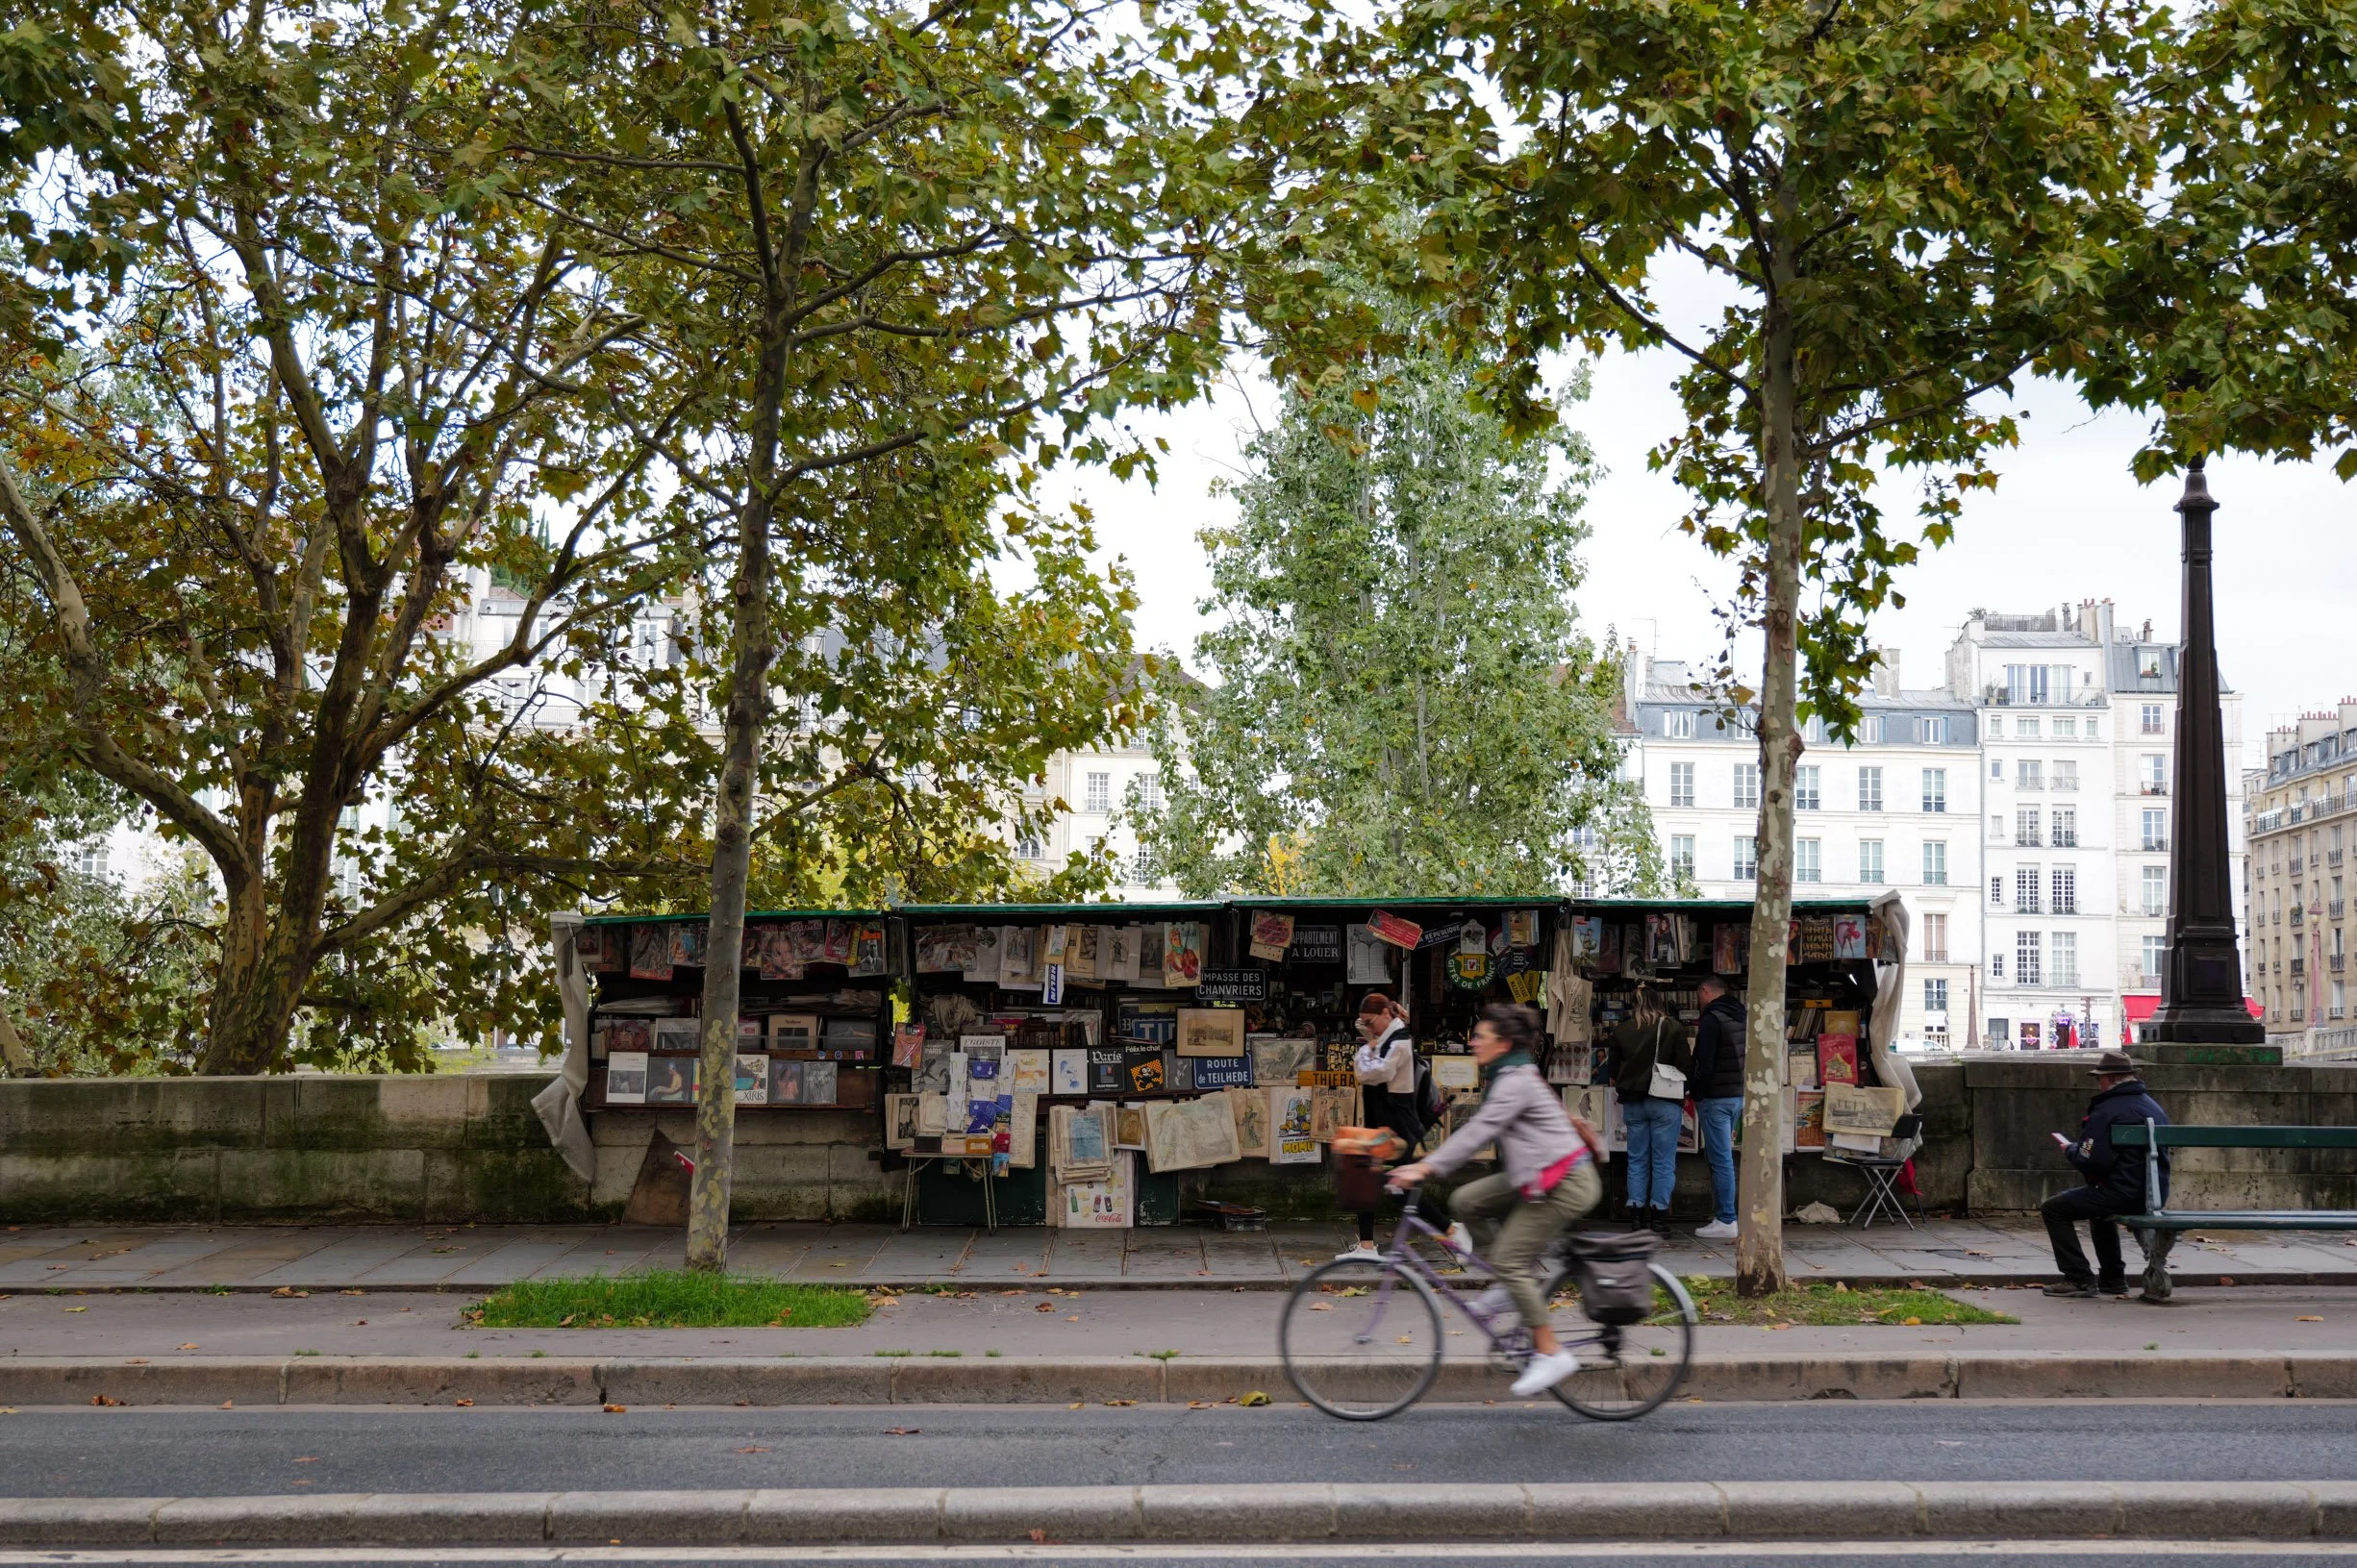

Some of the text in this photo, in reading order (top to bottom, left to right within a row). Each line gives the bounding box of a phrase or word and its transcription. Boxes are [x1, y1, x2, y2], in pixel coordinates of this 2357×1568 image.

[1291, 931, 1338, 945] APPARTEMENT
[1291, 947, 1340, 958] A LOUER
[1201, 972, 1260, 982] IMPASSE DES
[1447, 958, 1495, 989] GITES DE FRANCE
[1198, 984, 1262, 996] CHANVRIERS
[1091, 1050, 1122, 1061] Paris
[1207, 1058, 1239, 1069] ROUTE
[1197, 1070, 1249, 1083] de TEILHEDE
[1313, 1072, 1356, 1086] THIEBA
[1282, 1141, 1316, 1155] MOMO
